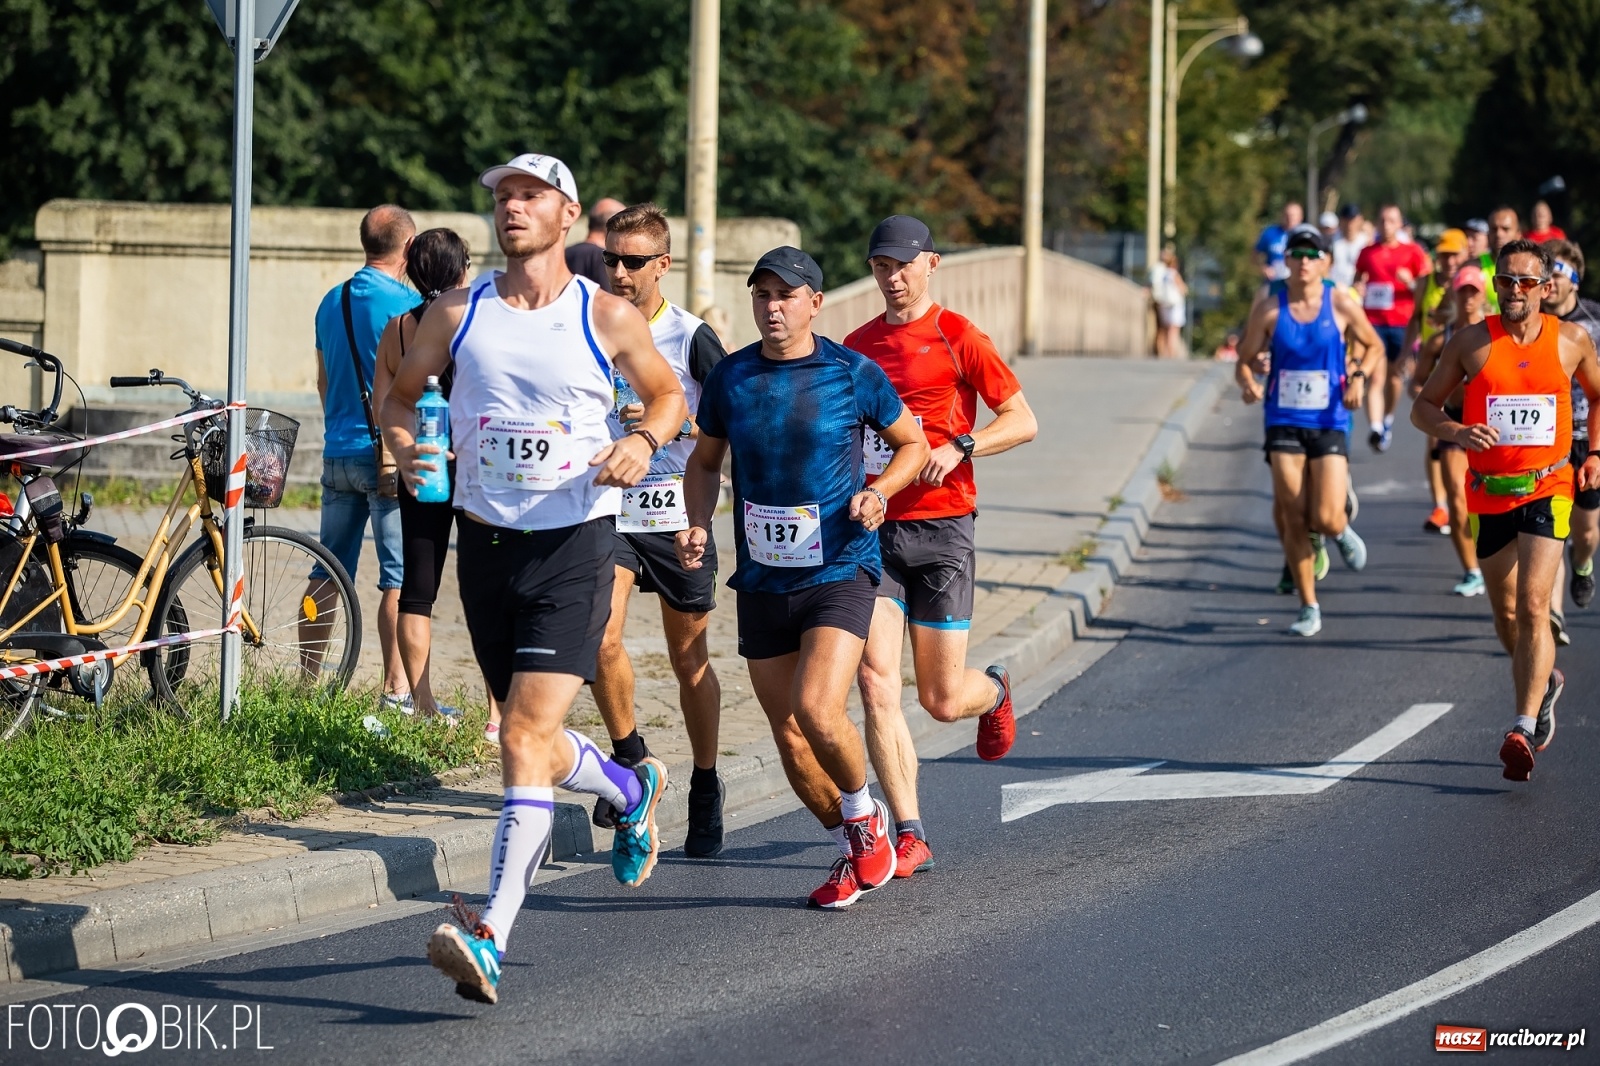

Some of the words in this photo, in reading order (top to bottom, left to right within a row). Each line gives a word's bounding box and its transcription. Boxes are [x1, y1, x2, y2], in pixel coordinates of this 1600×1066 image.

[1297, 382, 1311, 394] 76
[1510, 409, 1541, 425] 179
[506, 437, 550, 461] 159
[638, 489, 676, 509] 262
[763, 523, 799, 543] 137
